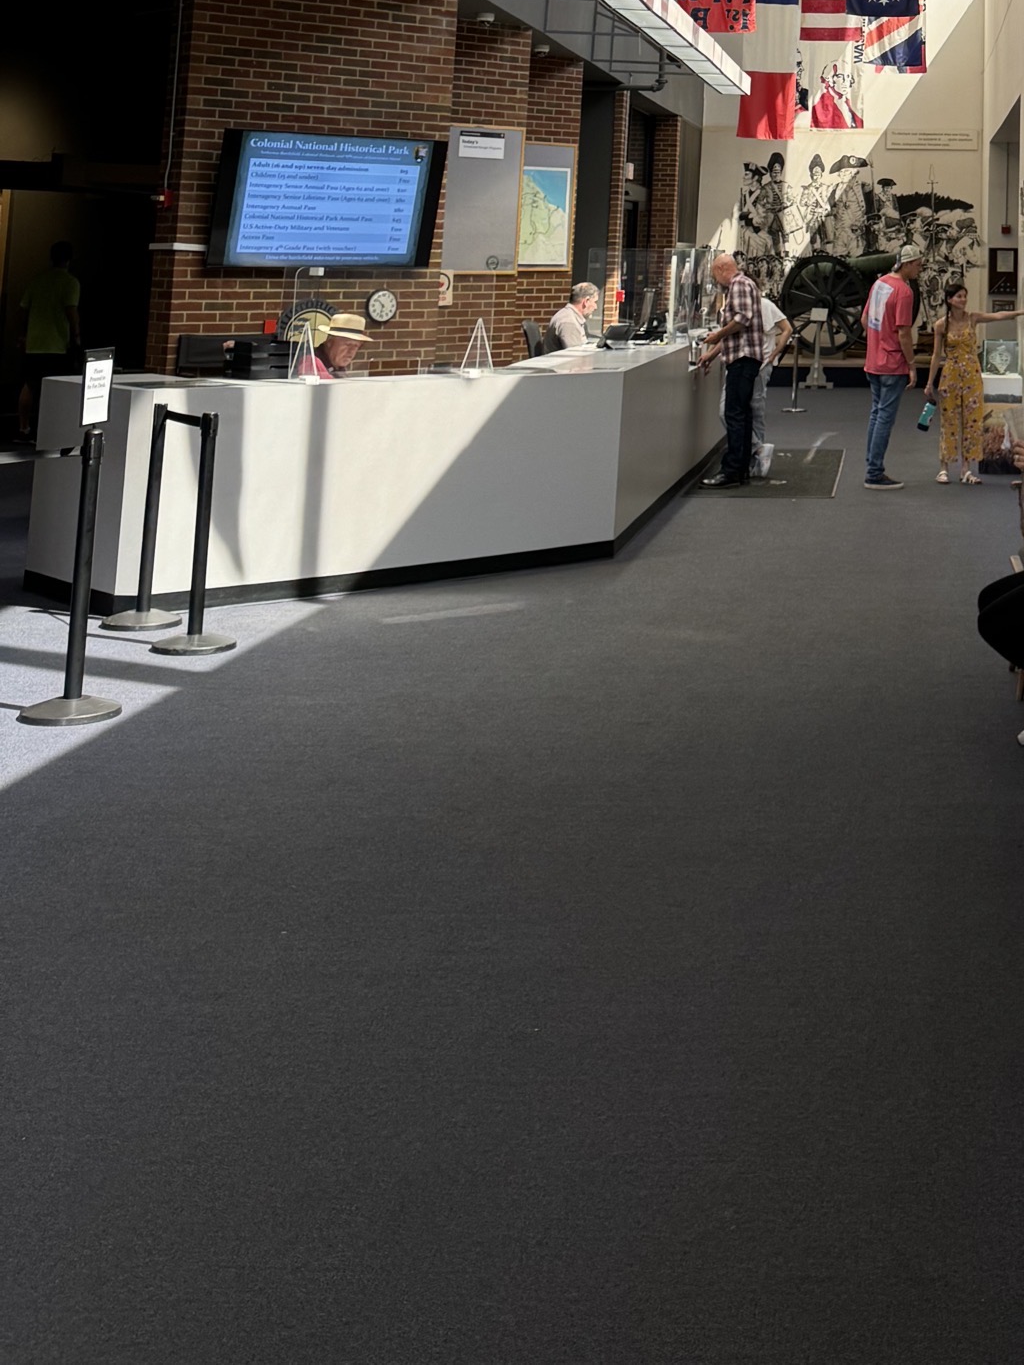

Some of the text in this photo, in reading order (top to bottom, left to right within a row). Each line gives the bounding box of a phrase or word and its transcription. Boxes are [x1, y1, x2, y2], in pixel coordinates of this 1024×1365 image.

[250, 138, 293, 149] Colonial
[295, 140, 337, 151] National
[340, 142, 386, 153] Historical
[388, 145, 409, 155] Park
